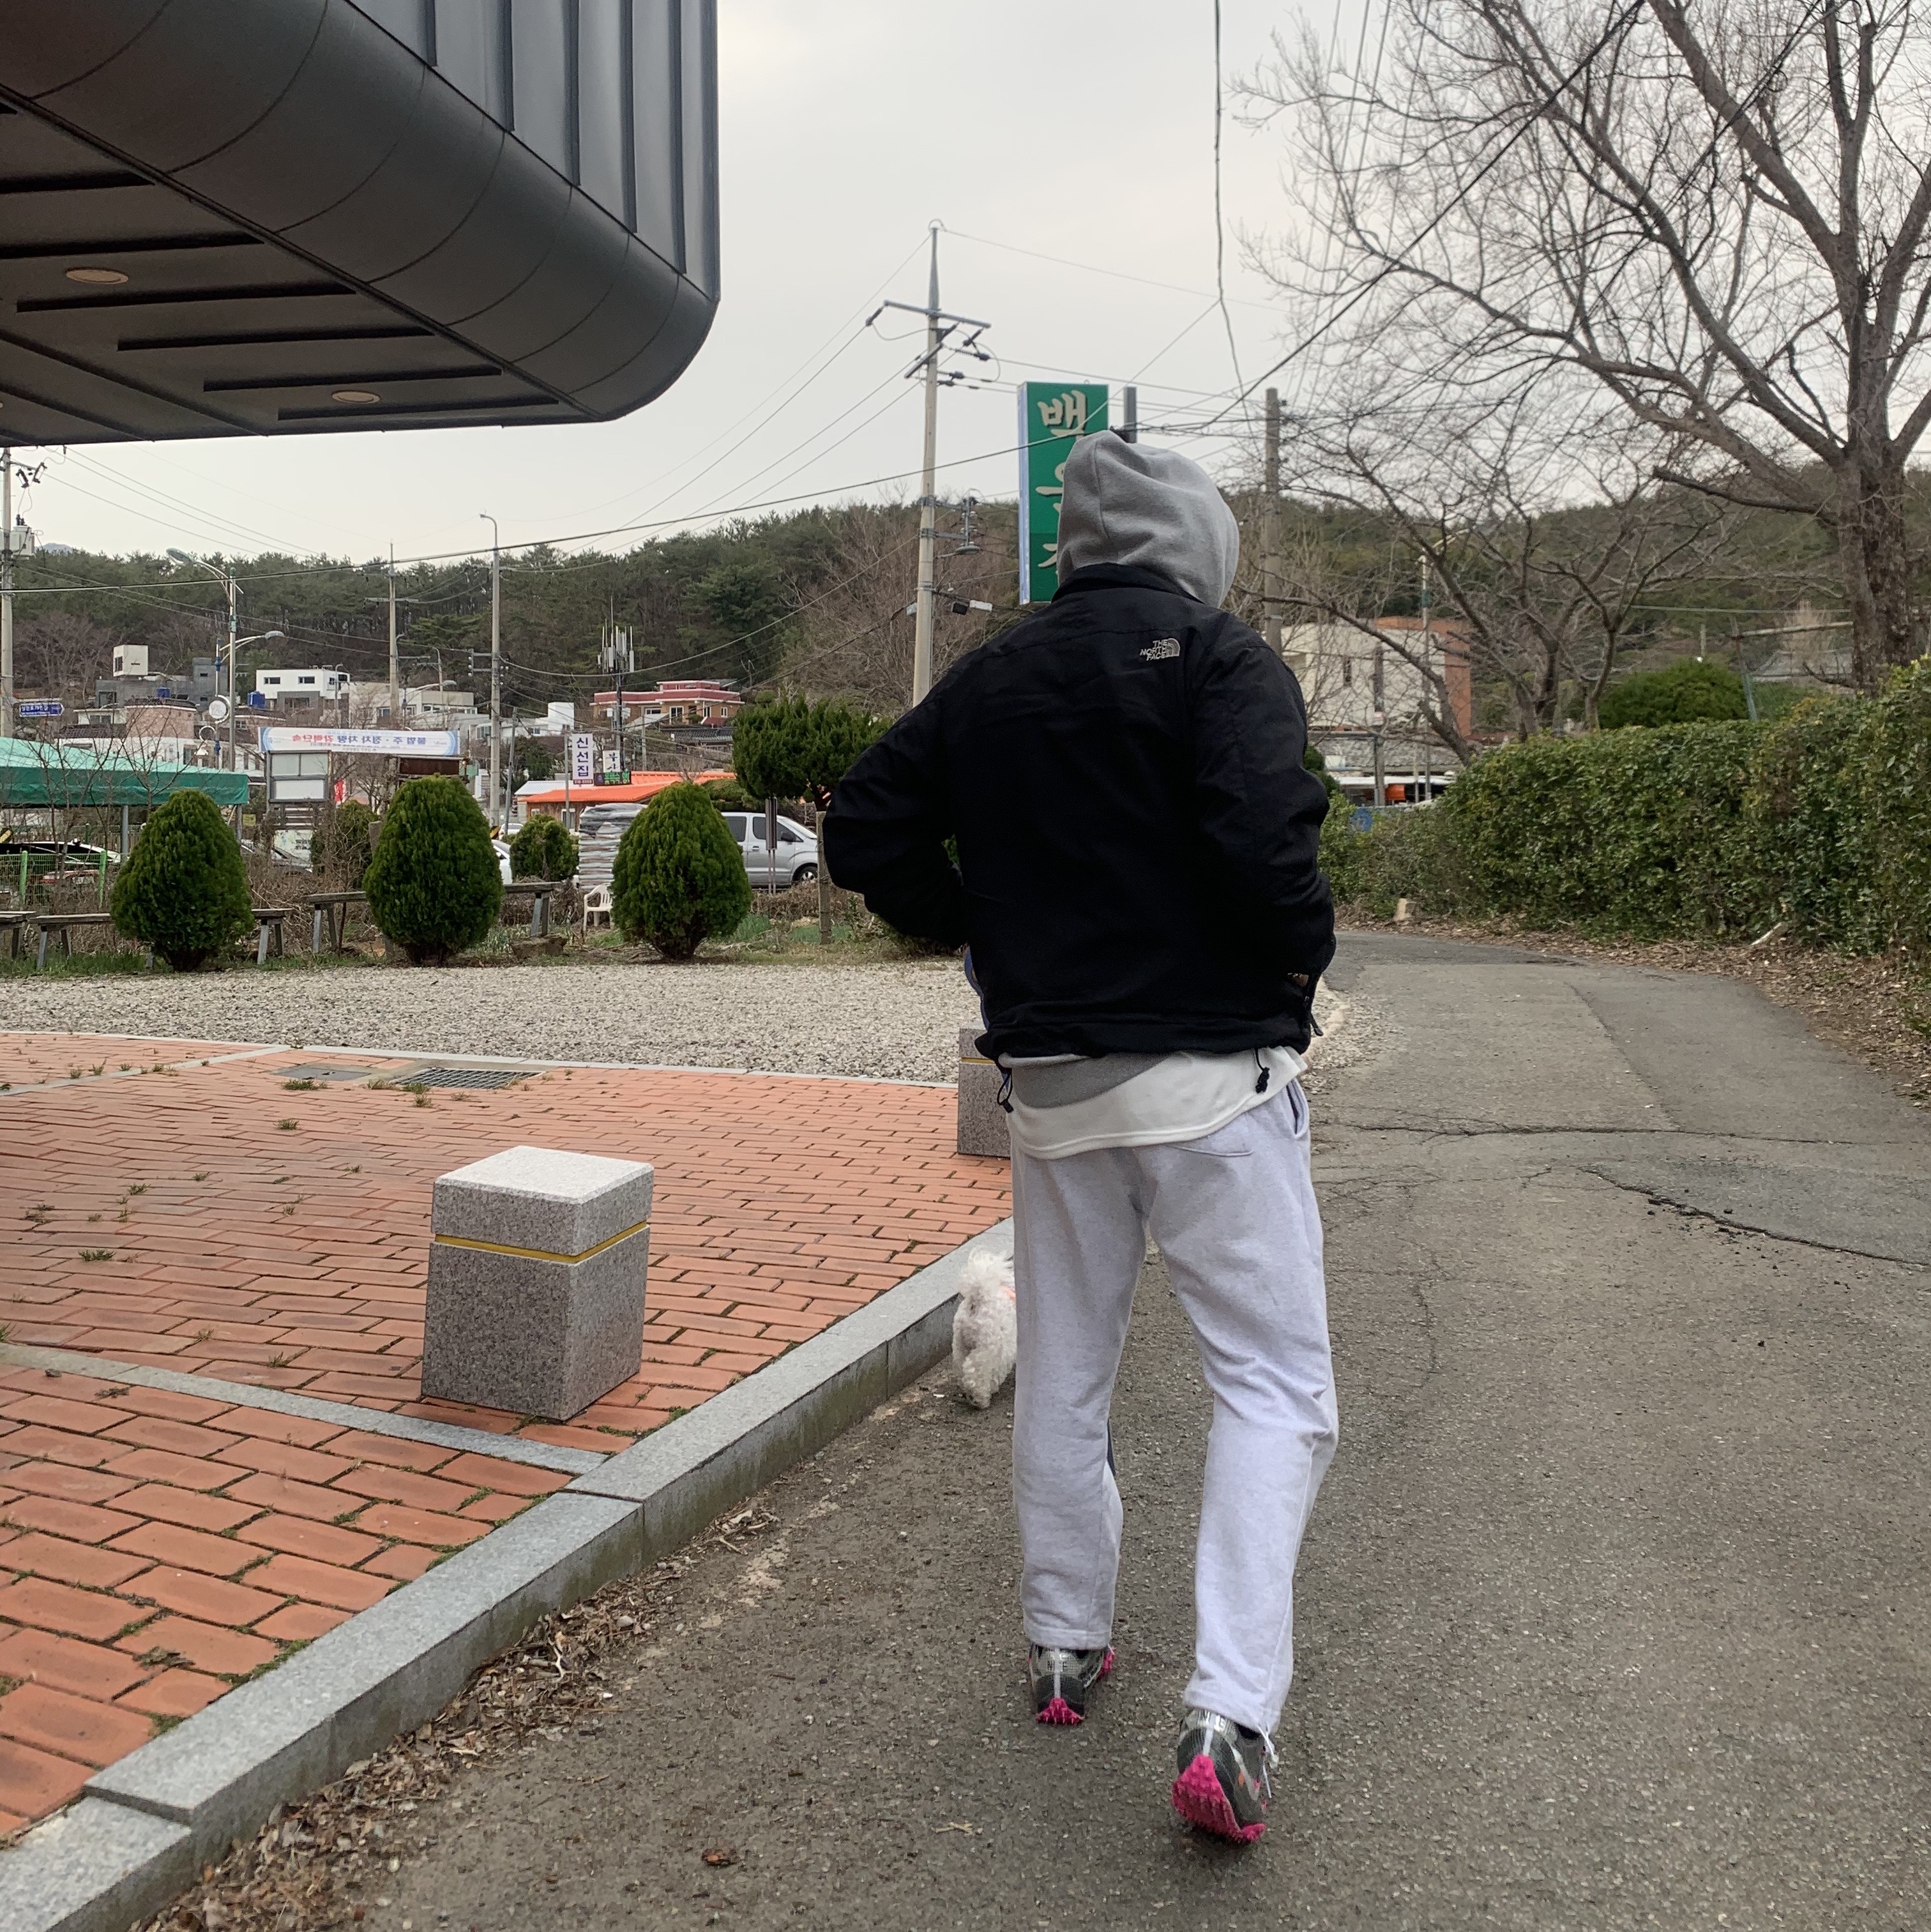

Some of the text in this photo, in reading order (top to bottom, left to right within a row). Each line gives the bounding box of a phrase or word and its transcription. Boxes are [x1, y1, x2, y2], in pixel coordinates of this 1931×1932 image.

[1153, 639, 1168, 648] THE
[1139, 646, 1167, 655] NORTH
[1146, 652, 1166, 661] FACE
[577, 737, 589, 777] 신선집
